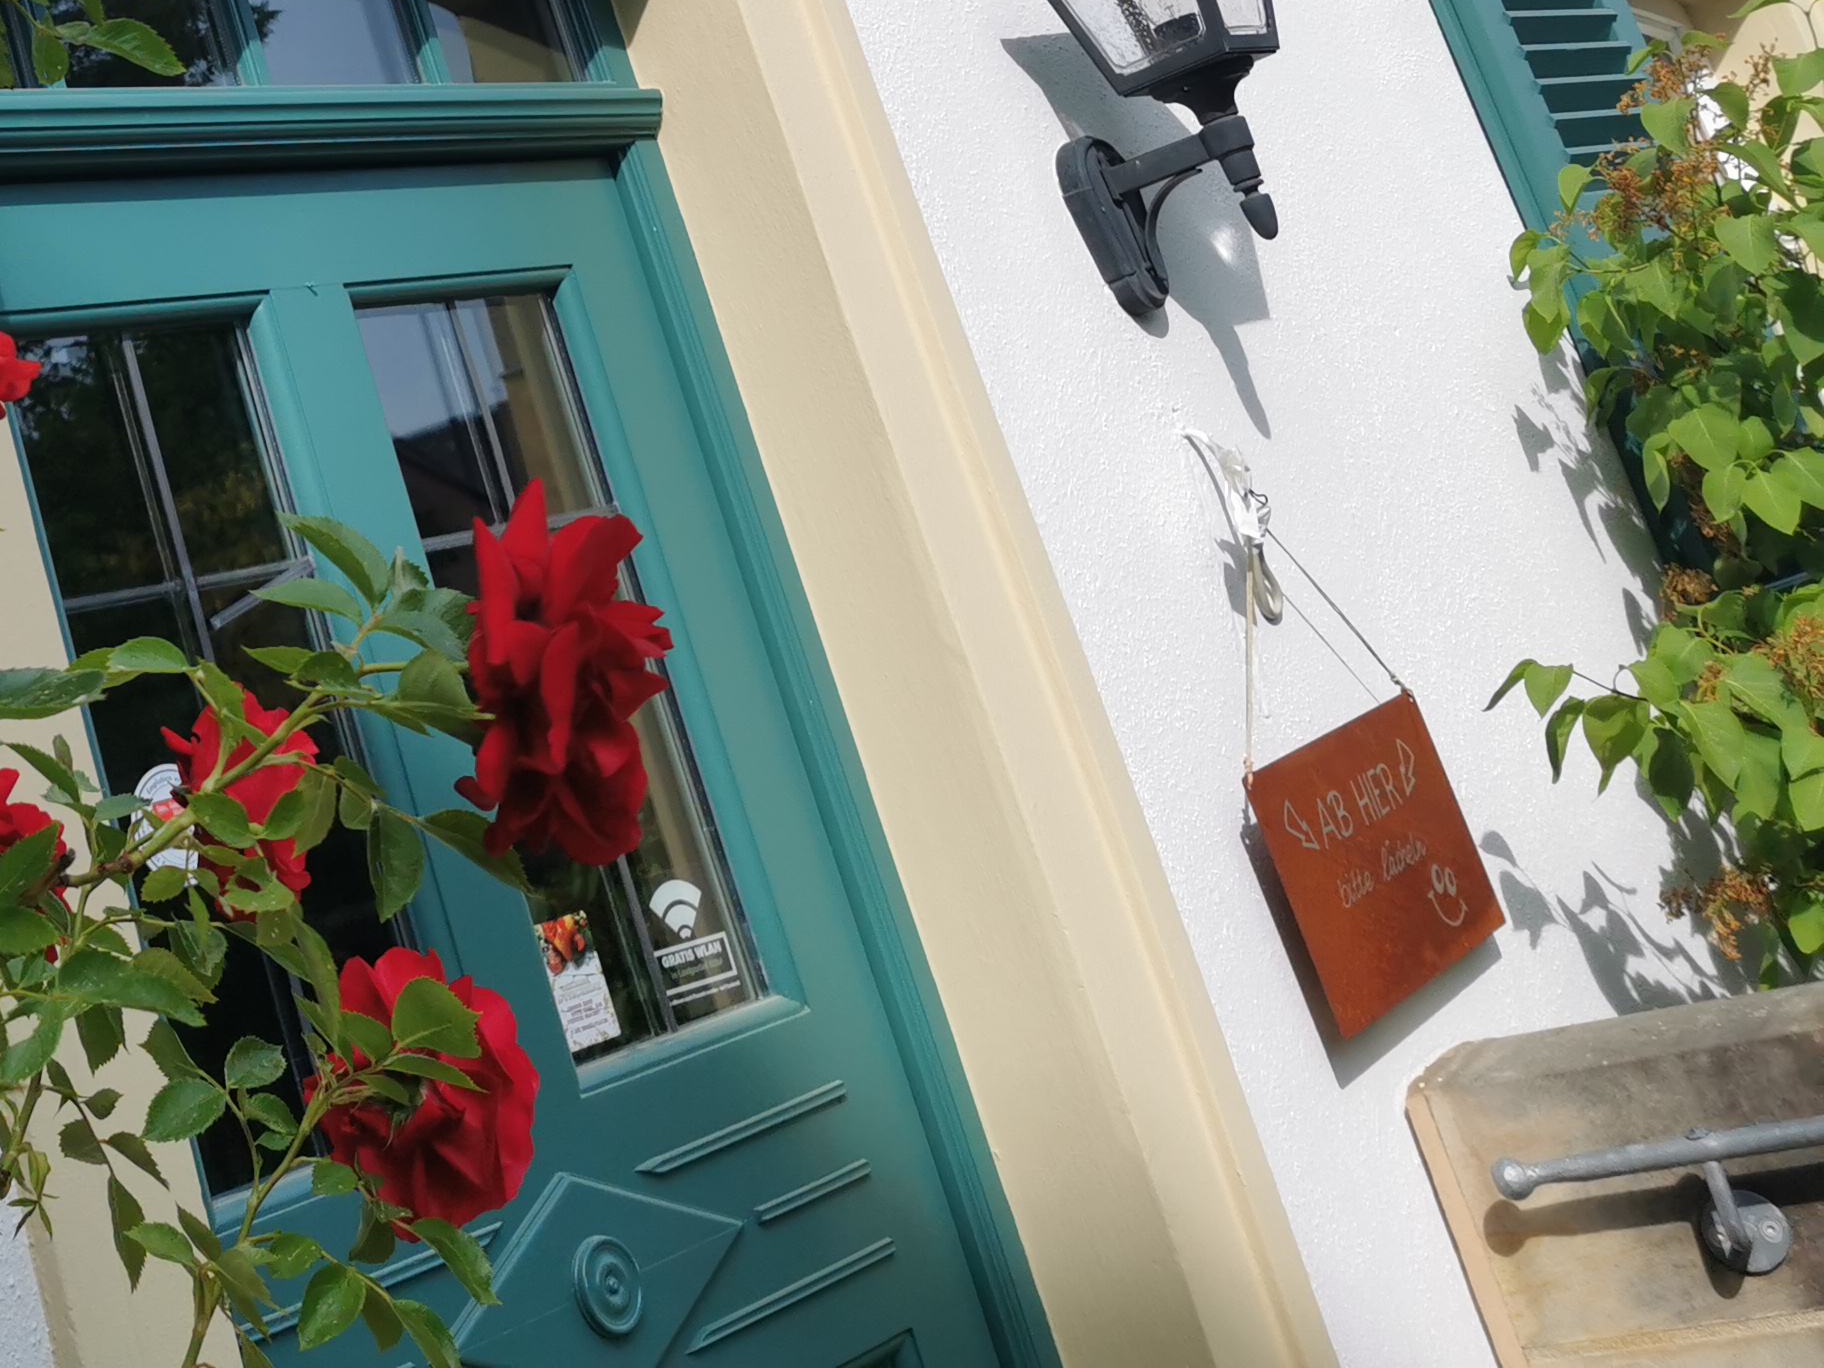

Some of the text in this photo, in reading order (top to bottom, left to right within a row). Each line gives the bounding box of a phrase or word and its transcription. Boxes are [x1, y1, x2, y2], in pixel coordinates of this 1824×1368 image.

[1316, 763, 1404, 850] AB HIER
[1336, 868, 1375, 908] bitte
[661, 948, 696, 969] GRATIS
[693, 940, 723, 960] WLAN
